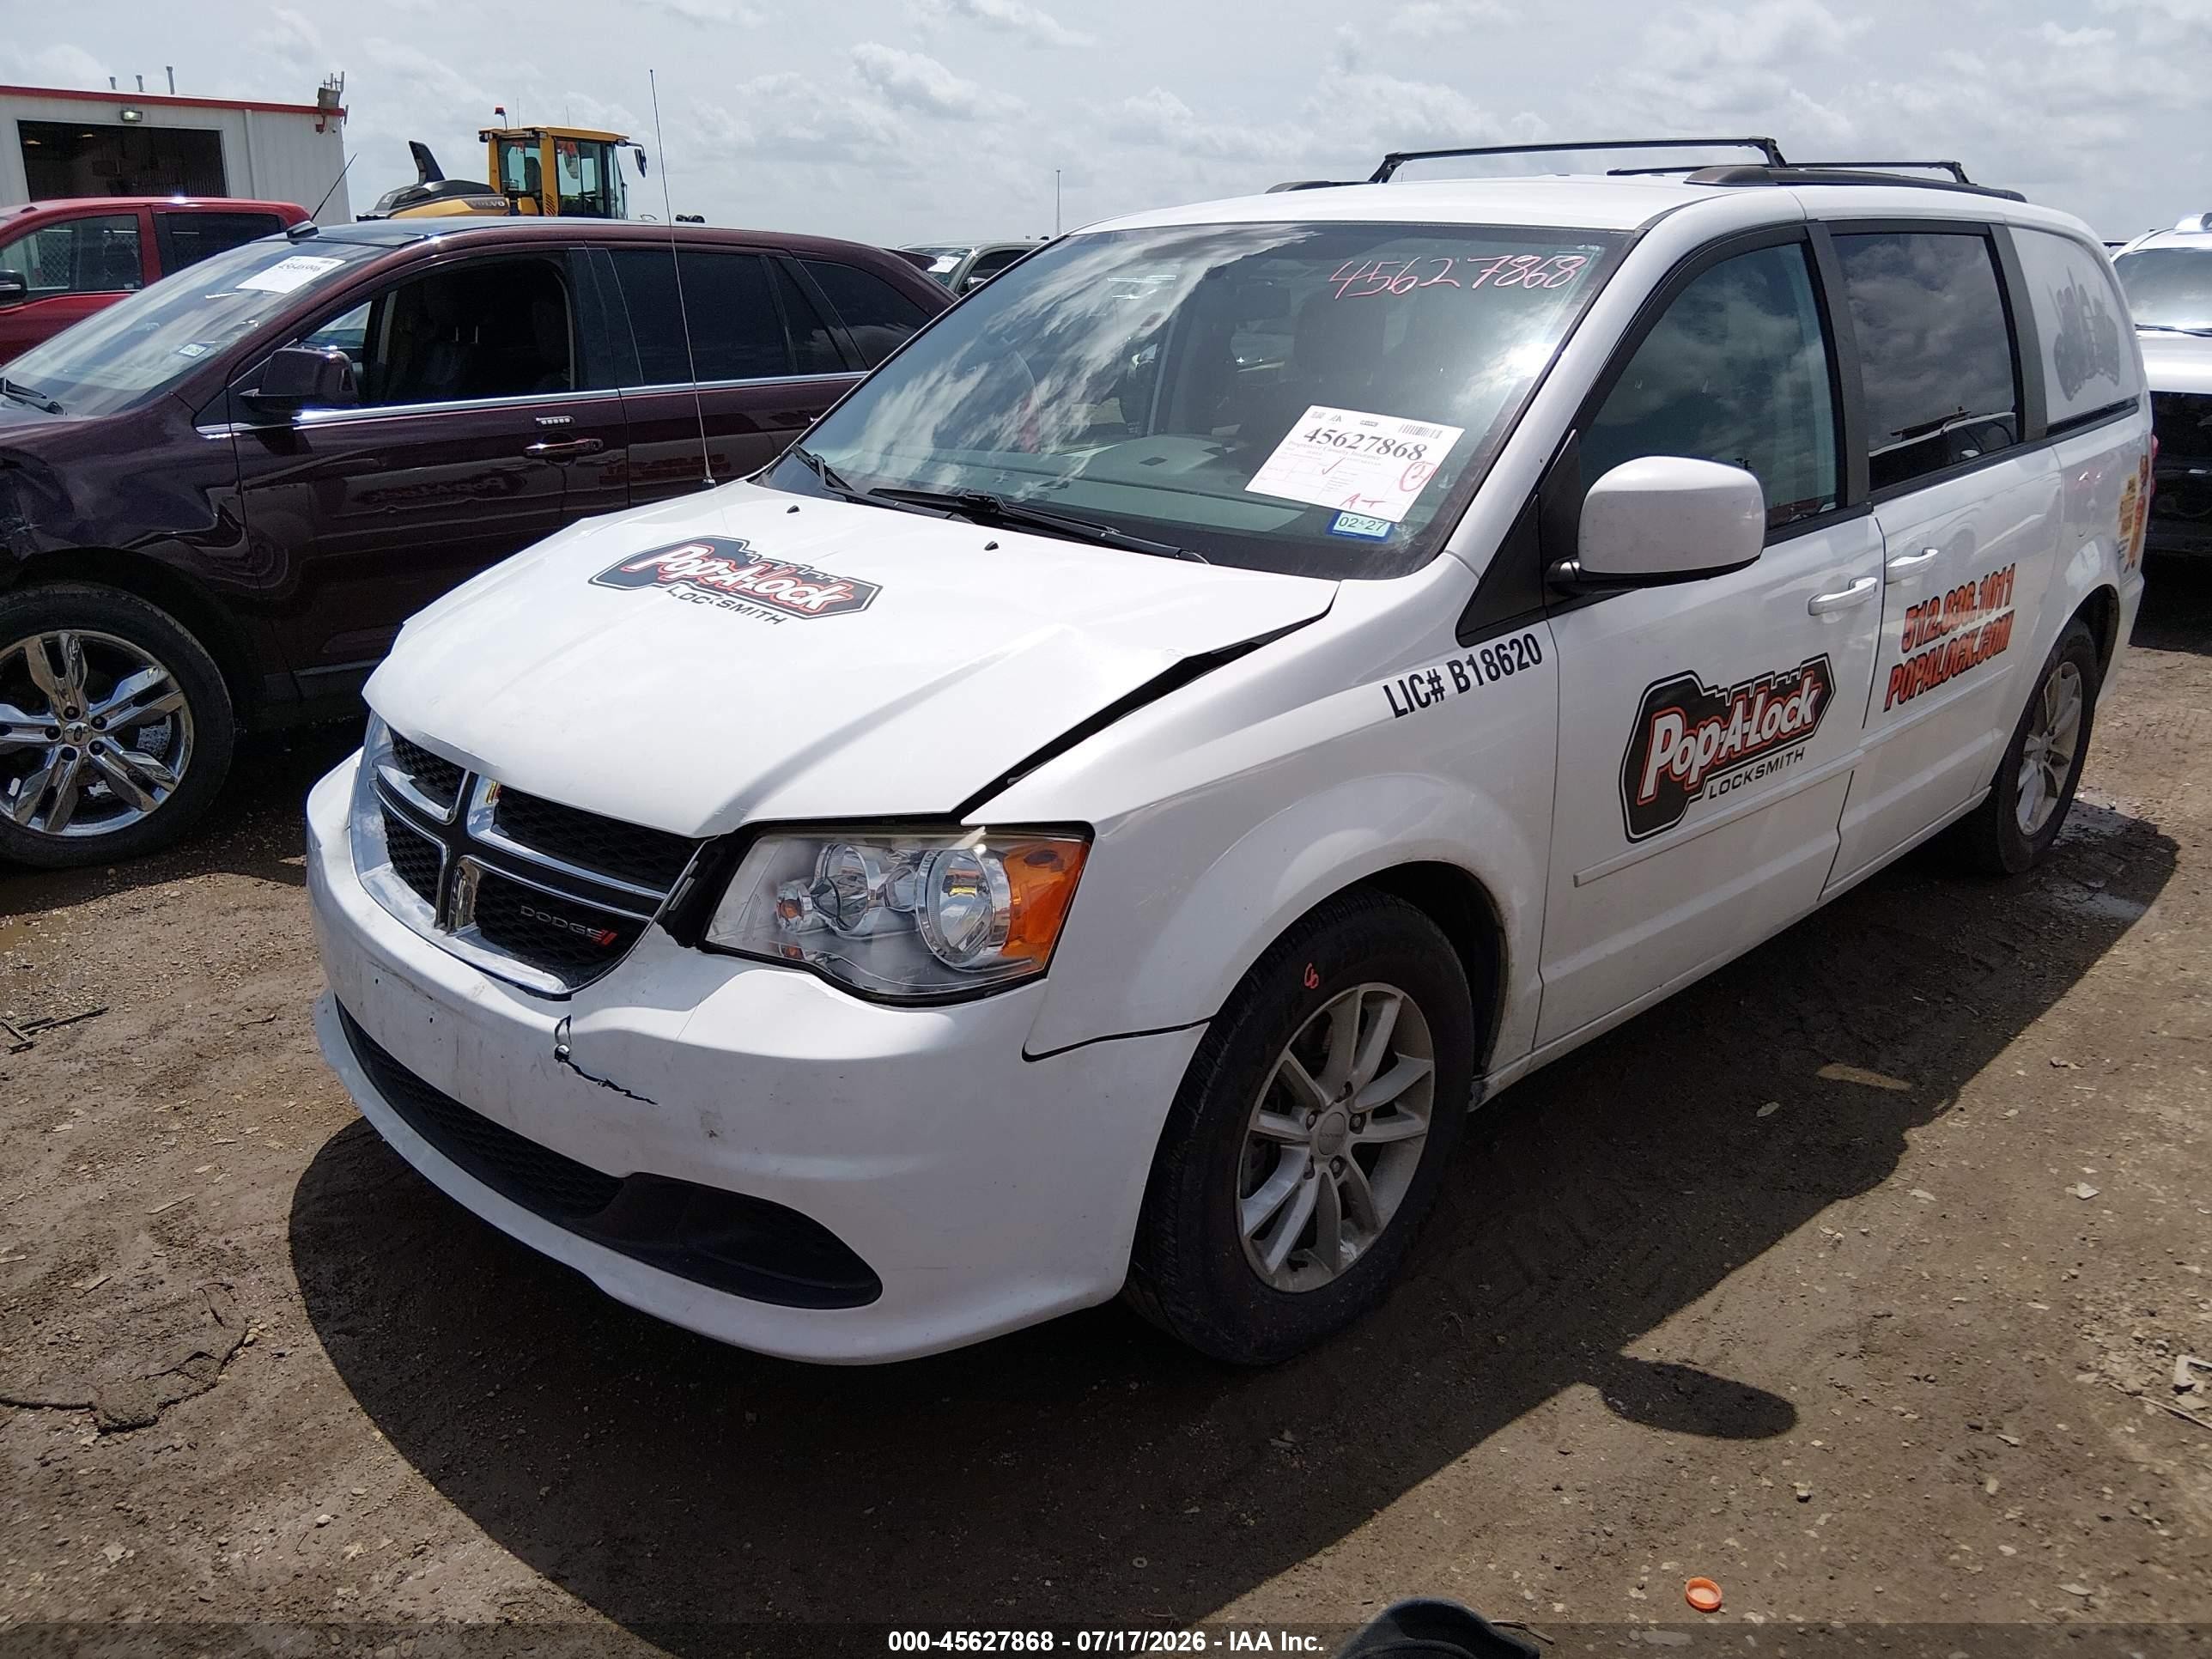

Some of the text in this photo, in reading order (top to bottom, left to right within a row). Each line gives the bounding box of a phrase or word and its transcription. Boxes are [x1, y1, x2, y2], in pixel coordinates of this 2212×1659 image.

[1303, 426, 1428, 461] 45627868
[666, 586, 788, 625] LOCKSMITH
[1382, 633, 1543, 719] LIC# B18620
[1883, 610, 2015, 713] POPALOCK.COM
[1709, 747, 1806, 799] LOCKSMITH
[520, 905, 605, 941] DODGE
